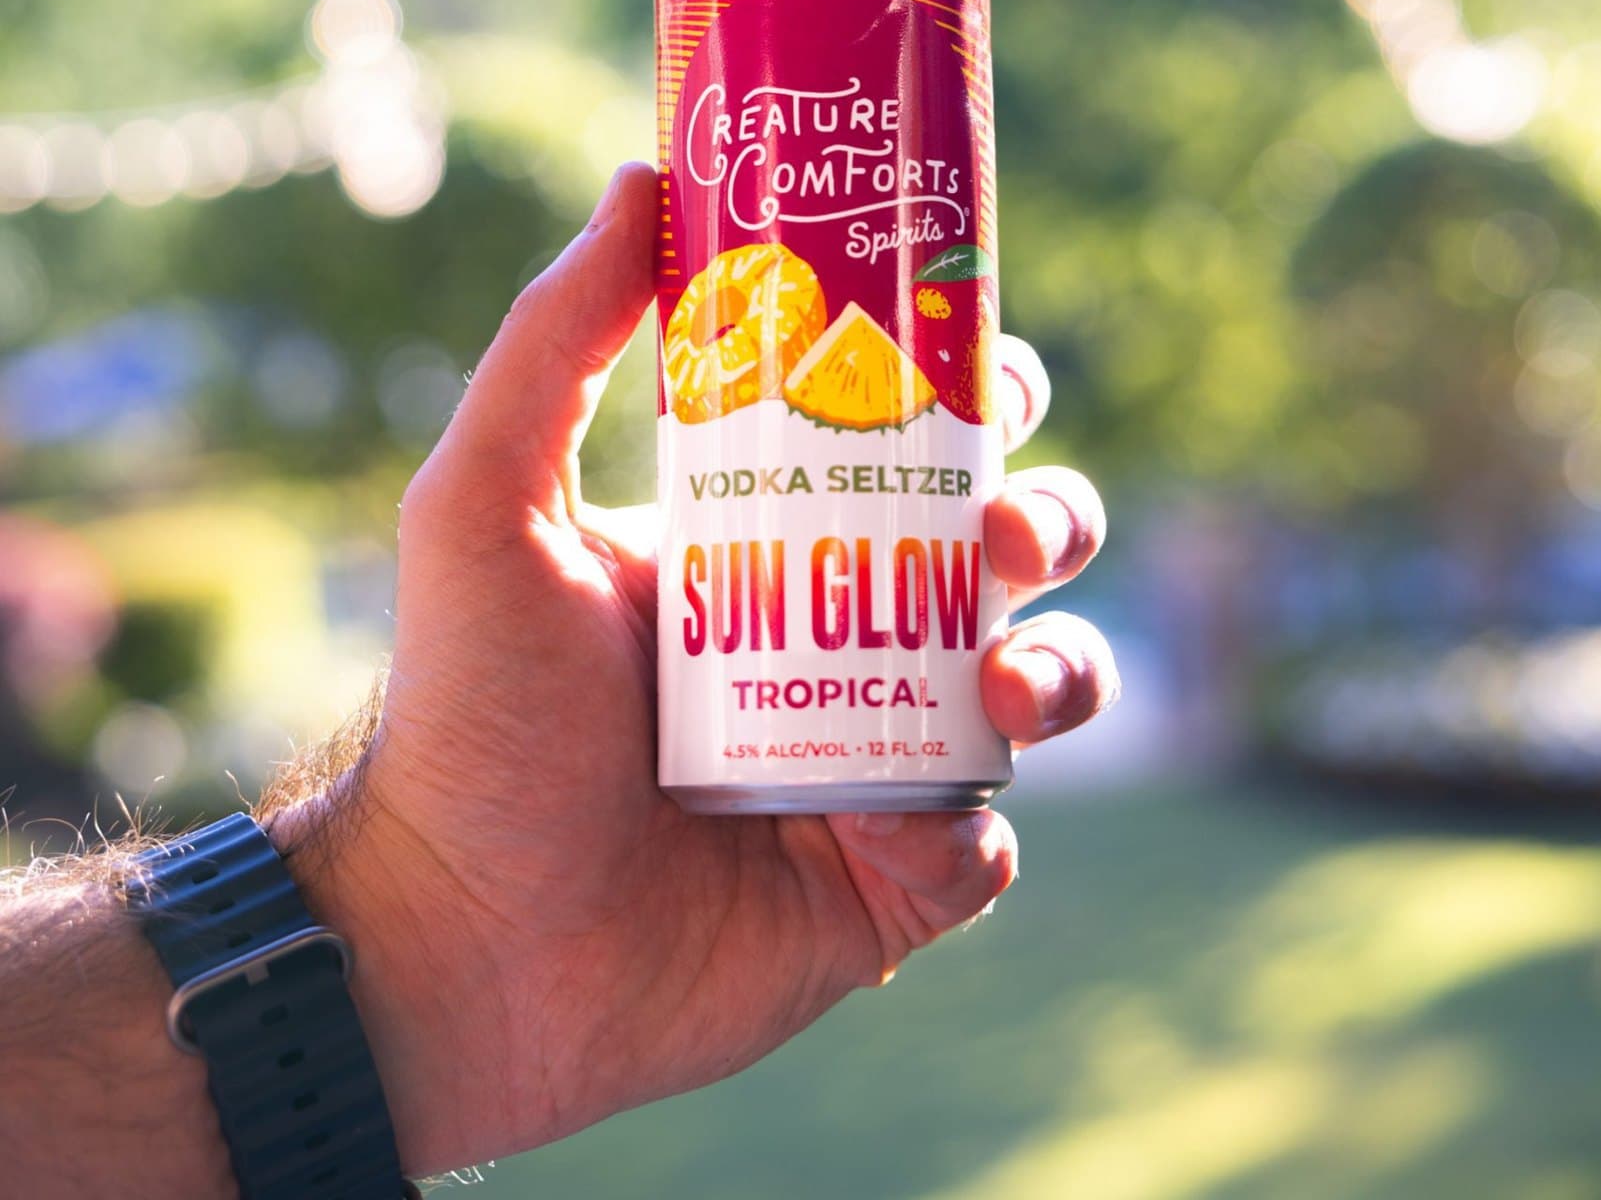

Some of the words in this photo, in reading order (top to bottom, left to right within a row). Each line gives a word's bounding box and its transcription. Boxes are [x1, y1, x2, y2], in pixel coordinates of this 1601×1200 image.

[687, 77, 901, 186] CREATURE
[846, 213, 944, 265] Spirits
[689, 466, 813, 501] VODKA
[827, 464, 972, 497] SELTZER
[683, 539, 786, 657] SUN
[811, 536, 980, 652] GLOW
[732, 677, 939, 710] TROPICAL
[722, 743, 760, 759] 4.5%
[766, 740, 850, 759] ALC/VOL
[868, 741, 885, 757] 12
[891, 741, 917, 757] FL.
[922, 741, 950, 757] OZ.
